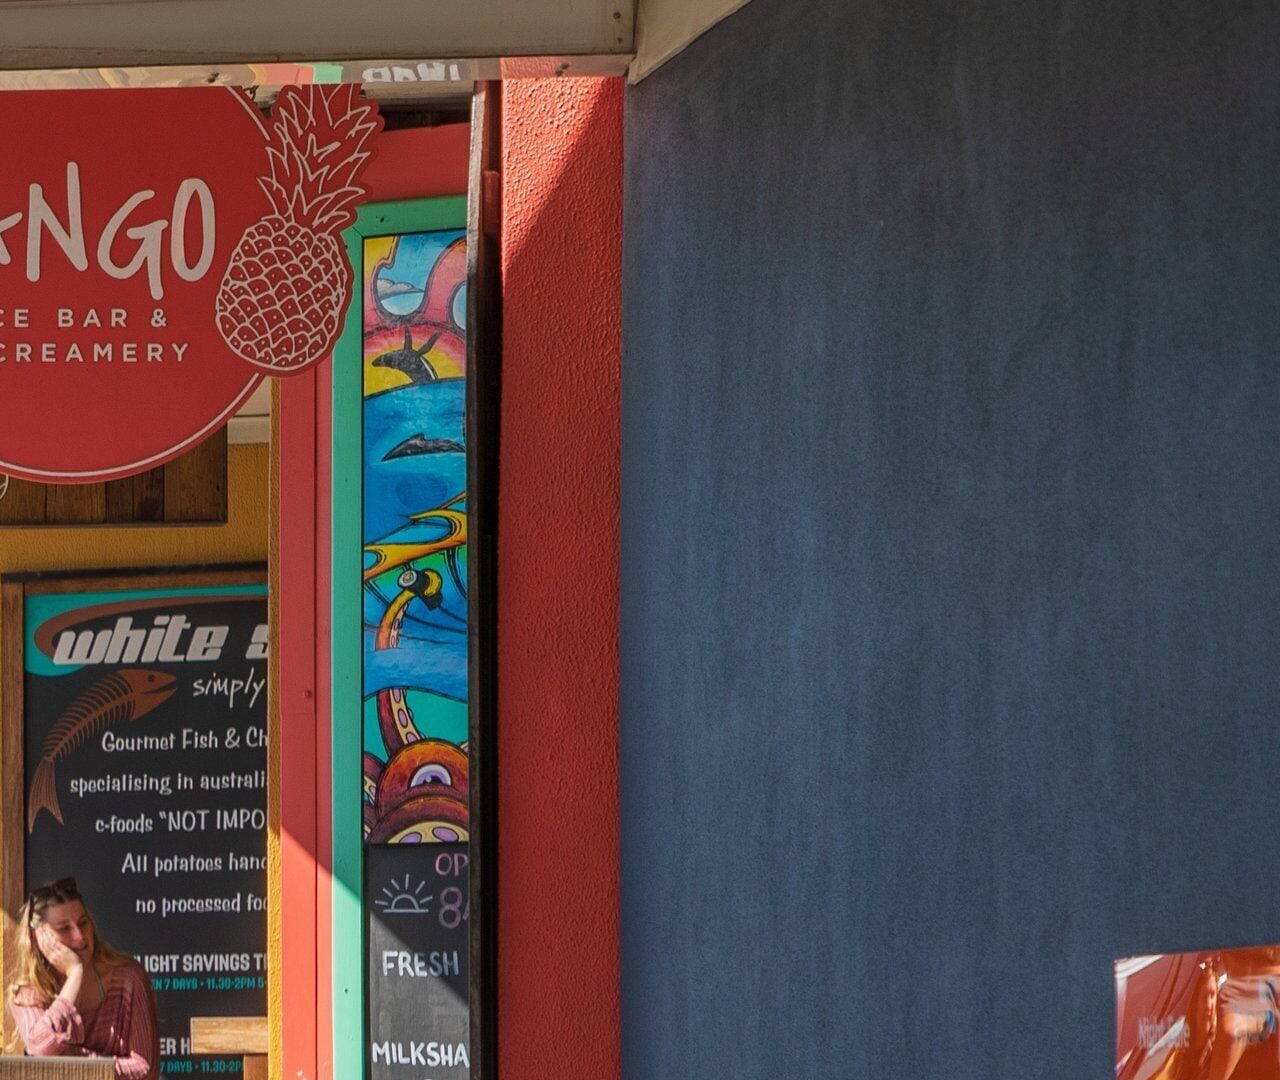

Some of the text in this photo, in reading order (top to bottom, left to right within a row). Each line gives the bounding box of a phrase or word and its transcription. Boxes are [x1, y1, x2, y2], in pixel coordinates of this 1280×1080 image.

[57, 308, 128, 328] BAR
[150, 308, 168, 328] &
[53, 614, 229, 665] white
[193, 667, 266, 709] simply
[101, 730, 176, 752] Gourmet
[182, 728, 219, 750] Fish
[224, 727, 241, 748] &
[69, 770, 268, 798] specialising in australi
[95, 813, 153, 834] c-foods
[216, 808, 266, 831] IMPO
[121, 852, 148, 874] All
[154, 853, 223, 877] potatoes
[135, 896, 156, 914] no
[162, 892, 241, 918] processed
[132, 955, 179, 973] IGHT
[182, 953, 251, 973] SAVINGS
[382, 950, 460, 978] FRESH
[164, 978, 171, 991] 7
[172, 977, 198, 991] DAYS
[167, 1061, 193, 1073] DAYS
[200, 1060, 244, 1073] 11.30-2P
[372, 1041, 470, 1069] MILKSHA
